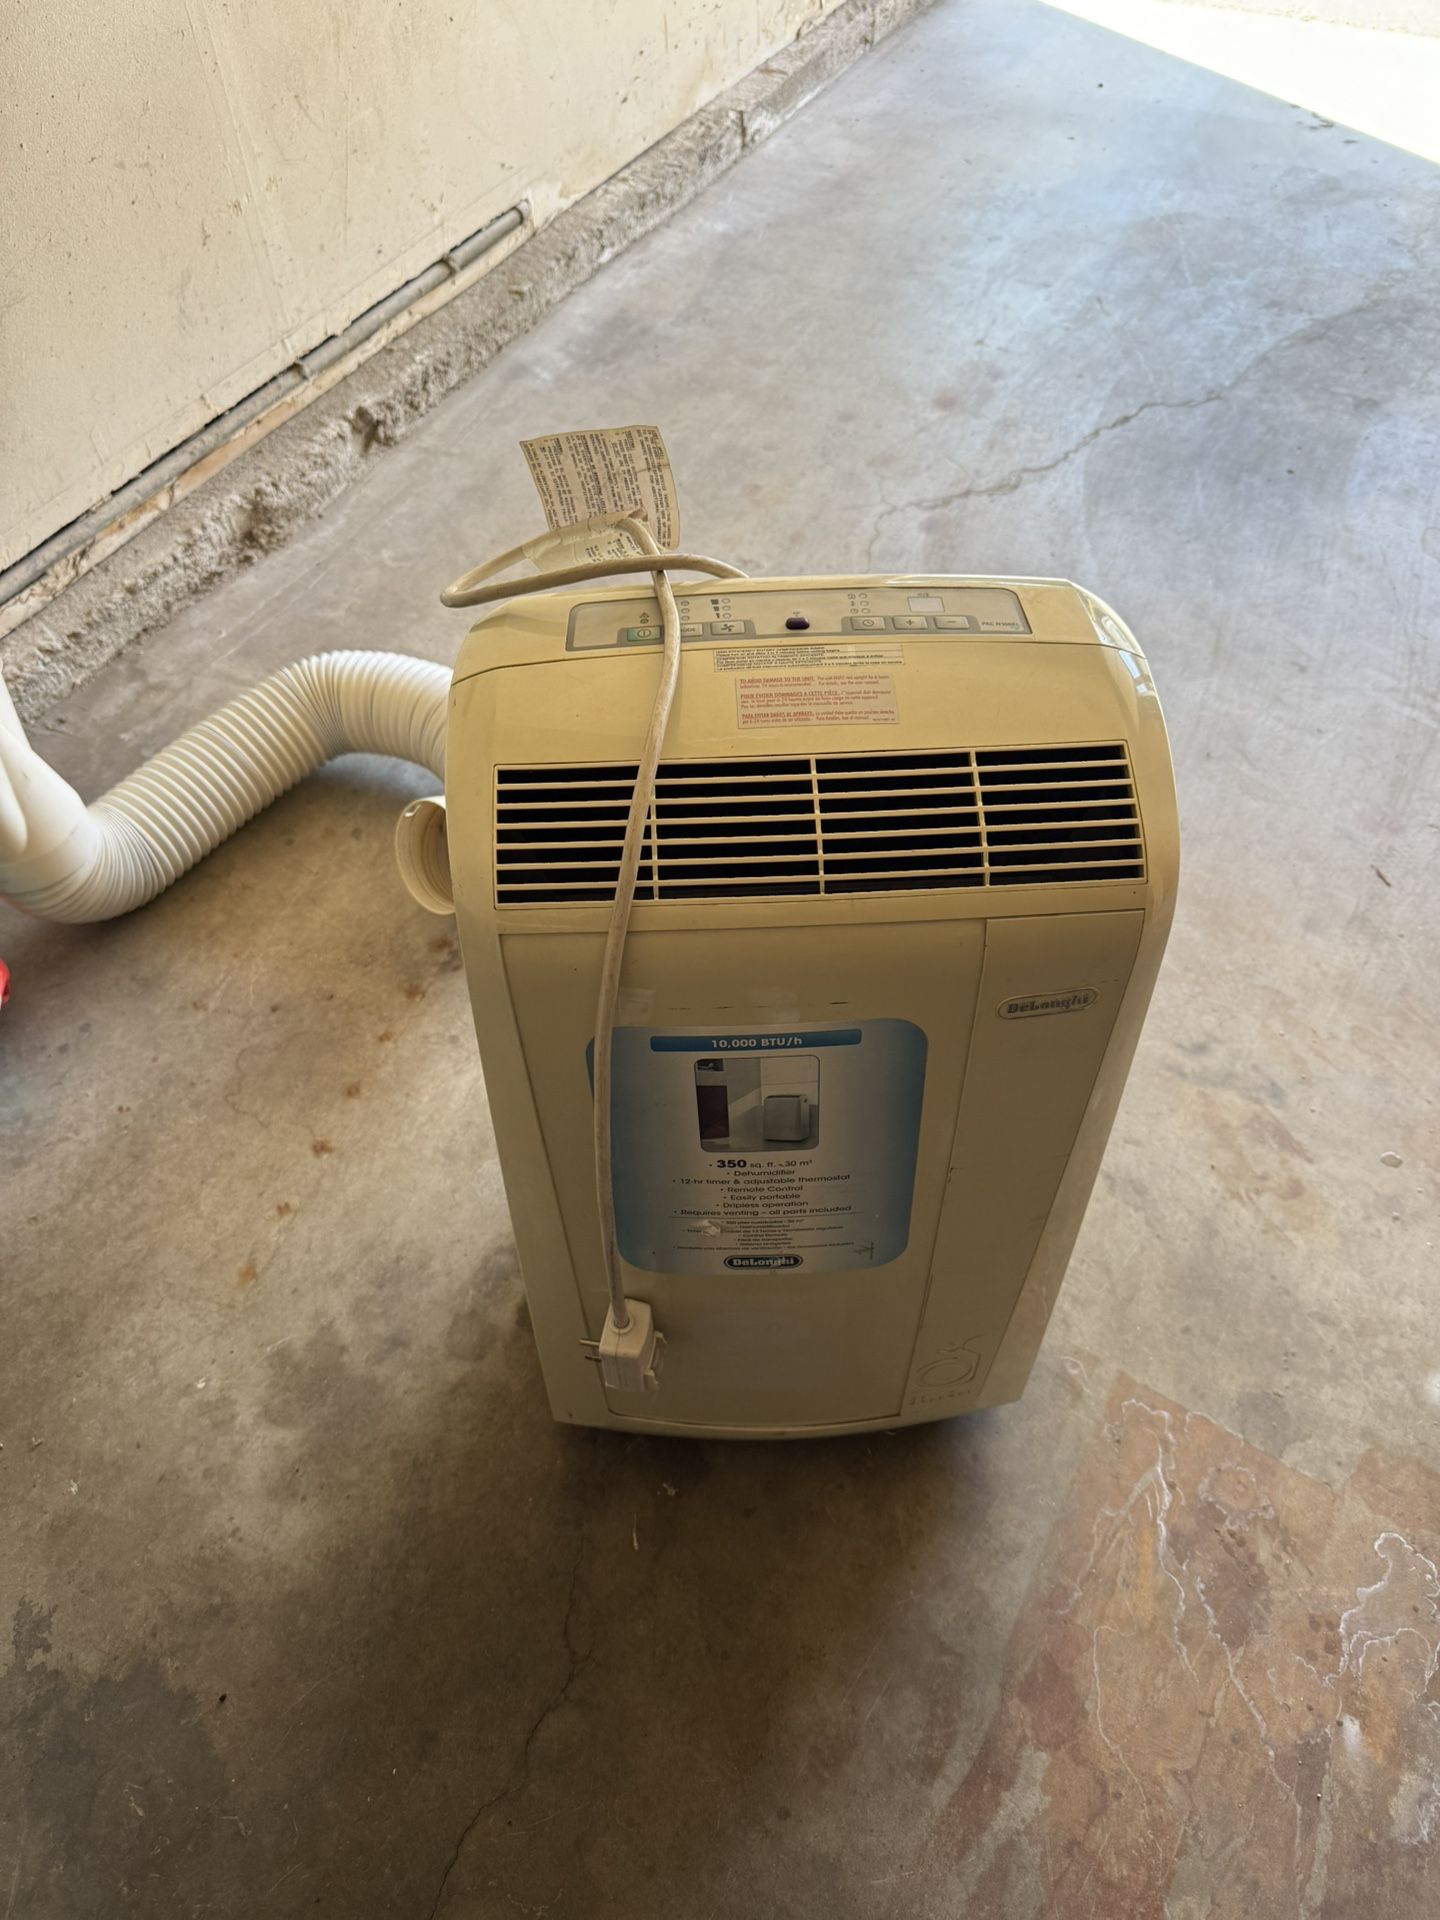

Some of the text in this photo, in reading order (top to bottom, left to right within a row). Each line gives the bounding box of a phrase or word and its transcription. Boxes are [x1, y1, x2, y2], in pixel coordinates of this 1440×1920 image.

[711, 1037, 802, 1049] 10,000 BTU/h
[716, 1159, 747, 1169] 350
[743, 1178, 795, 1186] adjustable
[798, 1174, 851, 1183] thermostat
[759, 1193, 801, 1201] portable
[761, 1201, 809, 1209] operation
[680, 1209, 721, 1217] Requires
[809, 1205, 852, 1214] included
[732, 1257, 795, 1267] DeLonghi
